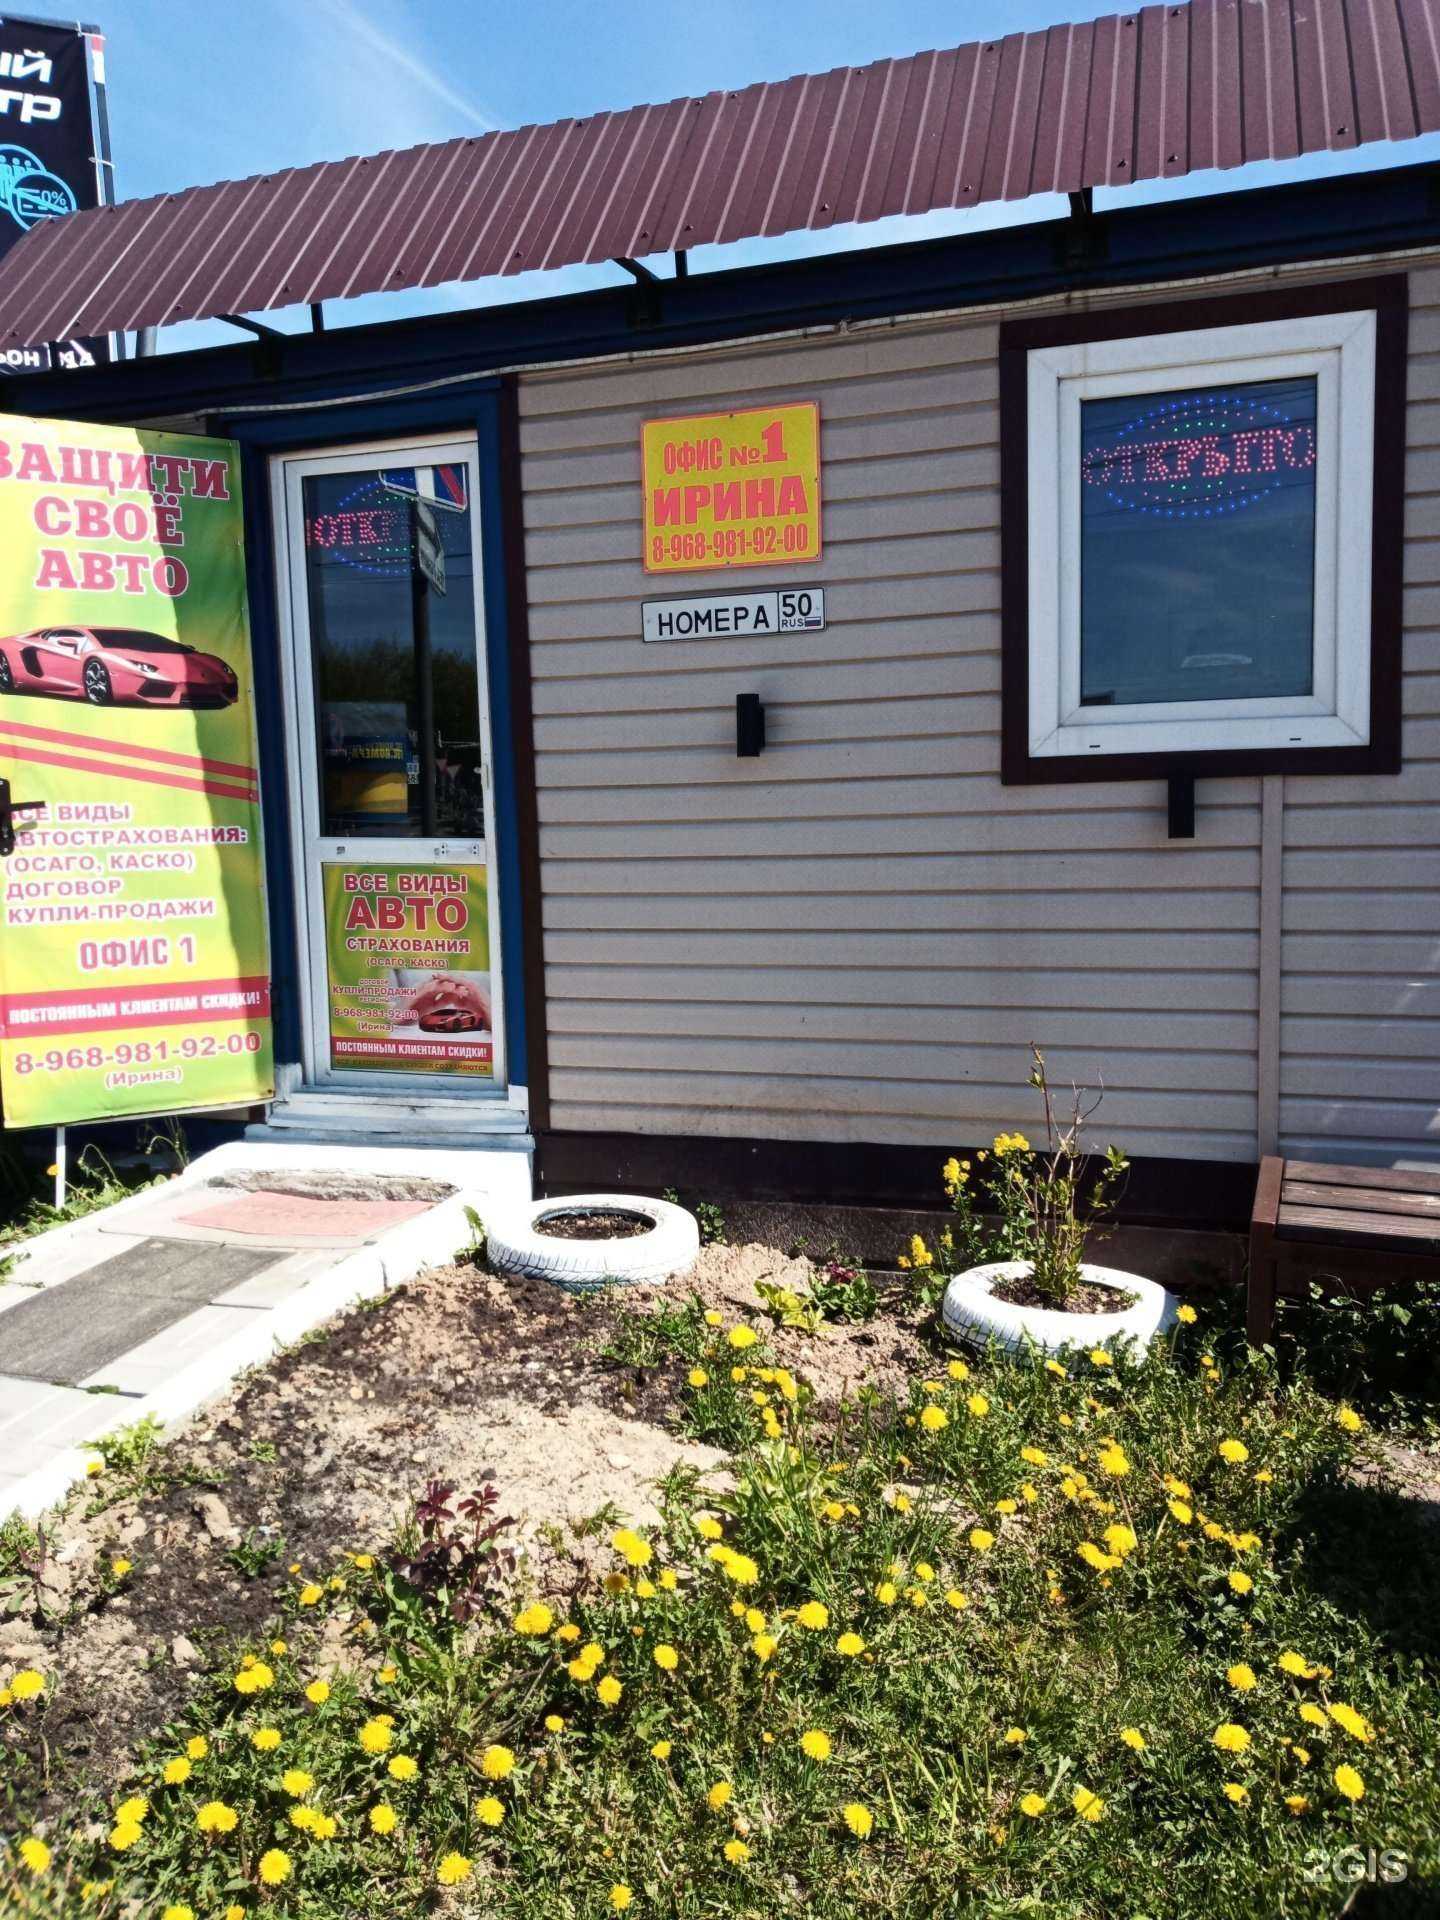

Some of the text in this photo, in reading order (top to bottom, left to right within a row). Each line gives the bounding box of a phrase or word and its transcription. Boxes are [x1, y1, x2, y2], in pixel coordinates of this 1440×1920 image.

[664, 437, 723, 475] ОФИС
[652, 475, 809, 526] ИРИНА
[33, 492, 184, 546] СВОЁ
[652, 523, 808, 563] 8-968-981-92-00
[36, 549, 189, 597] АВТО
[658, 593, 812, 637] НОМЕРА 50
[781, 617, 804, 629] RUS
[11, 804, 131, 822] СЕ ВИДЫ
[5, 852, 194, 877] (ОСАГО, КАСКО)
[6, 880, 122, 901] ДОГОВОР
[344, 874, 469, 896] ВСЕ ВИДЫ
[8, 900, 215, 924] КУПЛИ-ПРОДАЖИ
[345, 896, 469, 933] АВТО
[80, 937, 195, 970] ОФИС 1
[346, 937, 471, 954] СТРАХОВАНИЯ
[8, 990, 261, 1025] ПОСТОЯННЫМ КЛИЕНТАМ СКИДКИ!
[15, 1031, 262, 1075] 8-968-981-92-00
[335, 1041, 488, 1058] ПОСТОЯННЫМ КЛИЕНТАМ СКИДКИ!
[105, 1066, 183, 1089] (Ирина)
